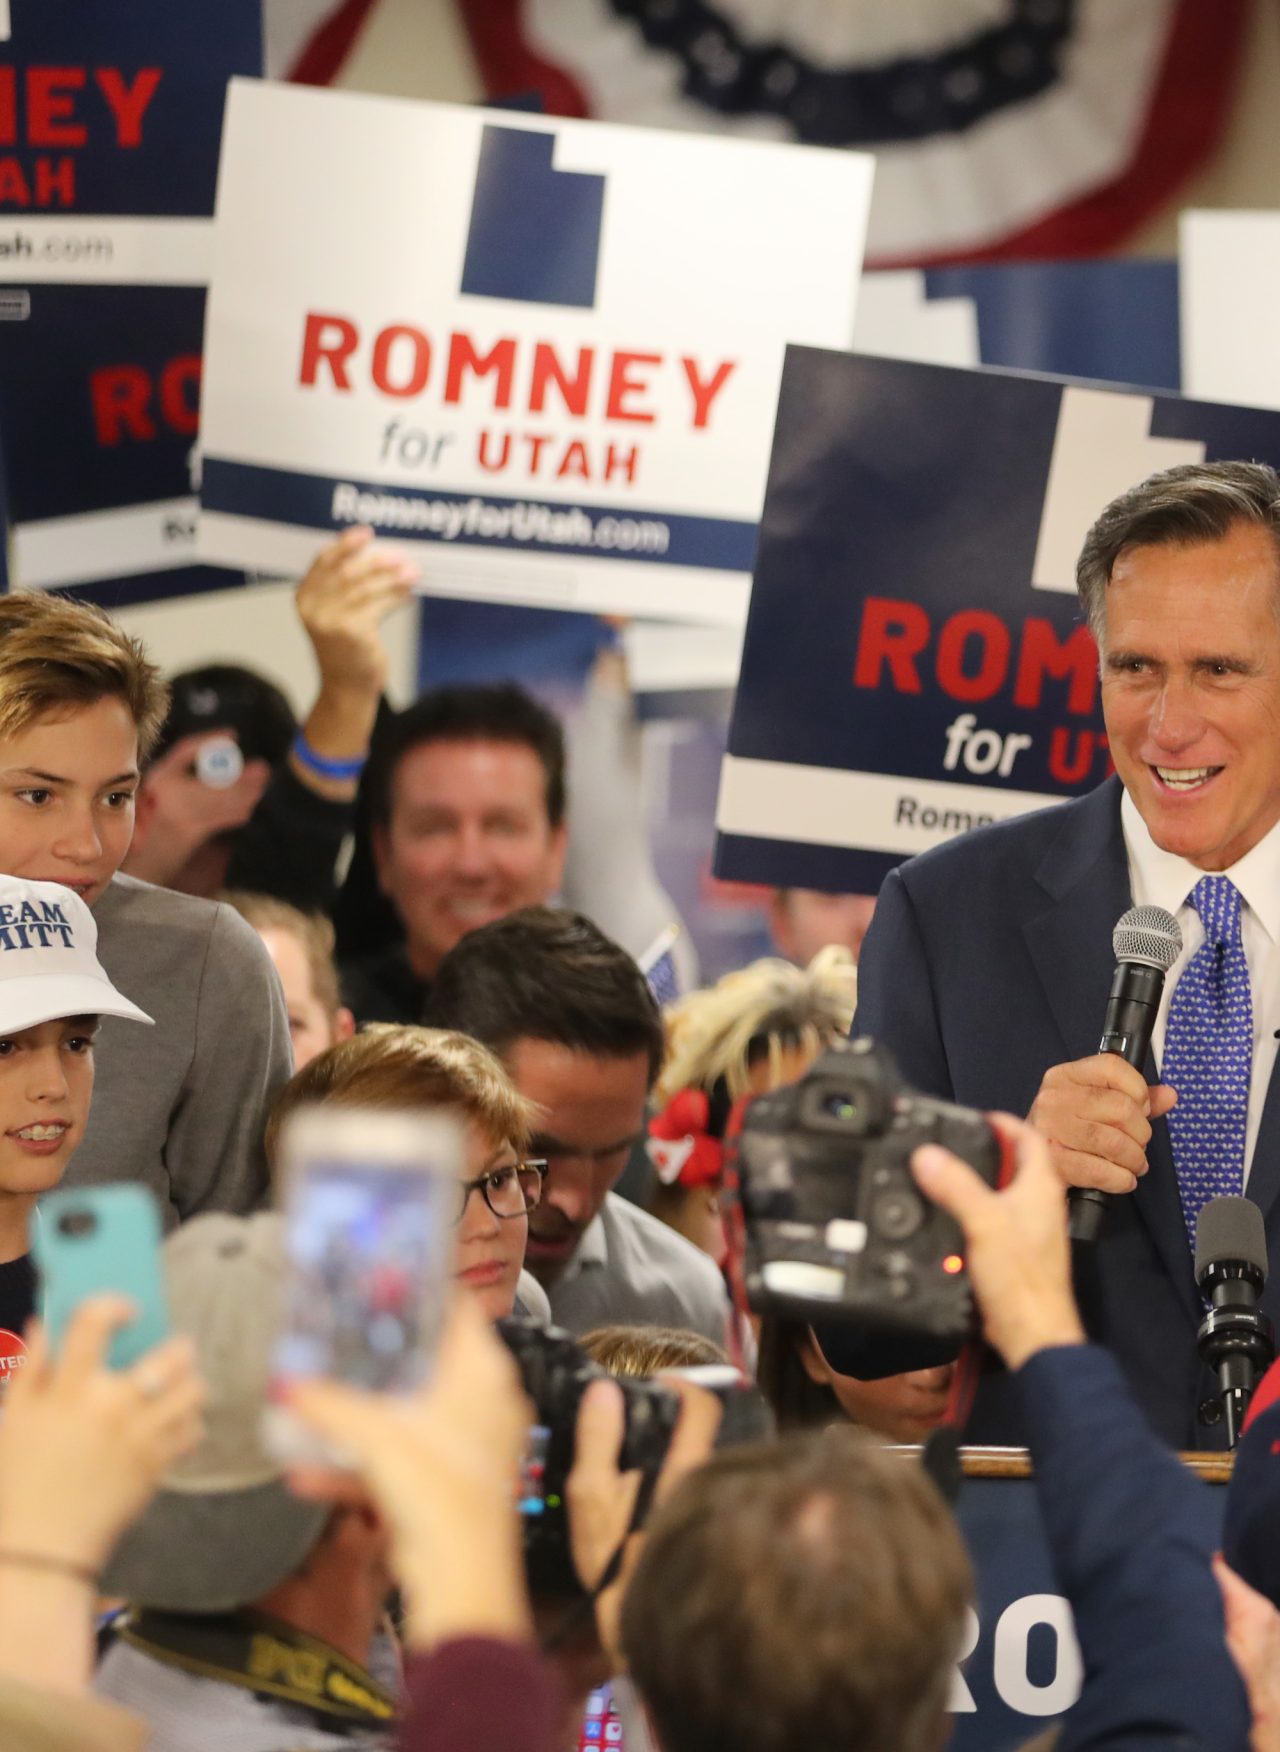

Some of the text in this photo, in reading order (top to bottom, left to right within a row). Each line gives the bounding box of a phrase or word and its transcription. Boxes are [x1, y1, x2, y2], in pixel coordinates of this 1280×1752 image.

[298, 310, 738, 431] ROMNEY
[378, 417, 641, 485] for UTAH
[330, 481, 671, 555] RomneyforUtah.com
[852, 595, 1101, 717] ROM
[943, 712, 1033, 778] for
